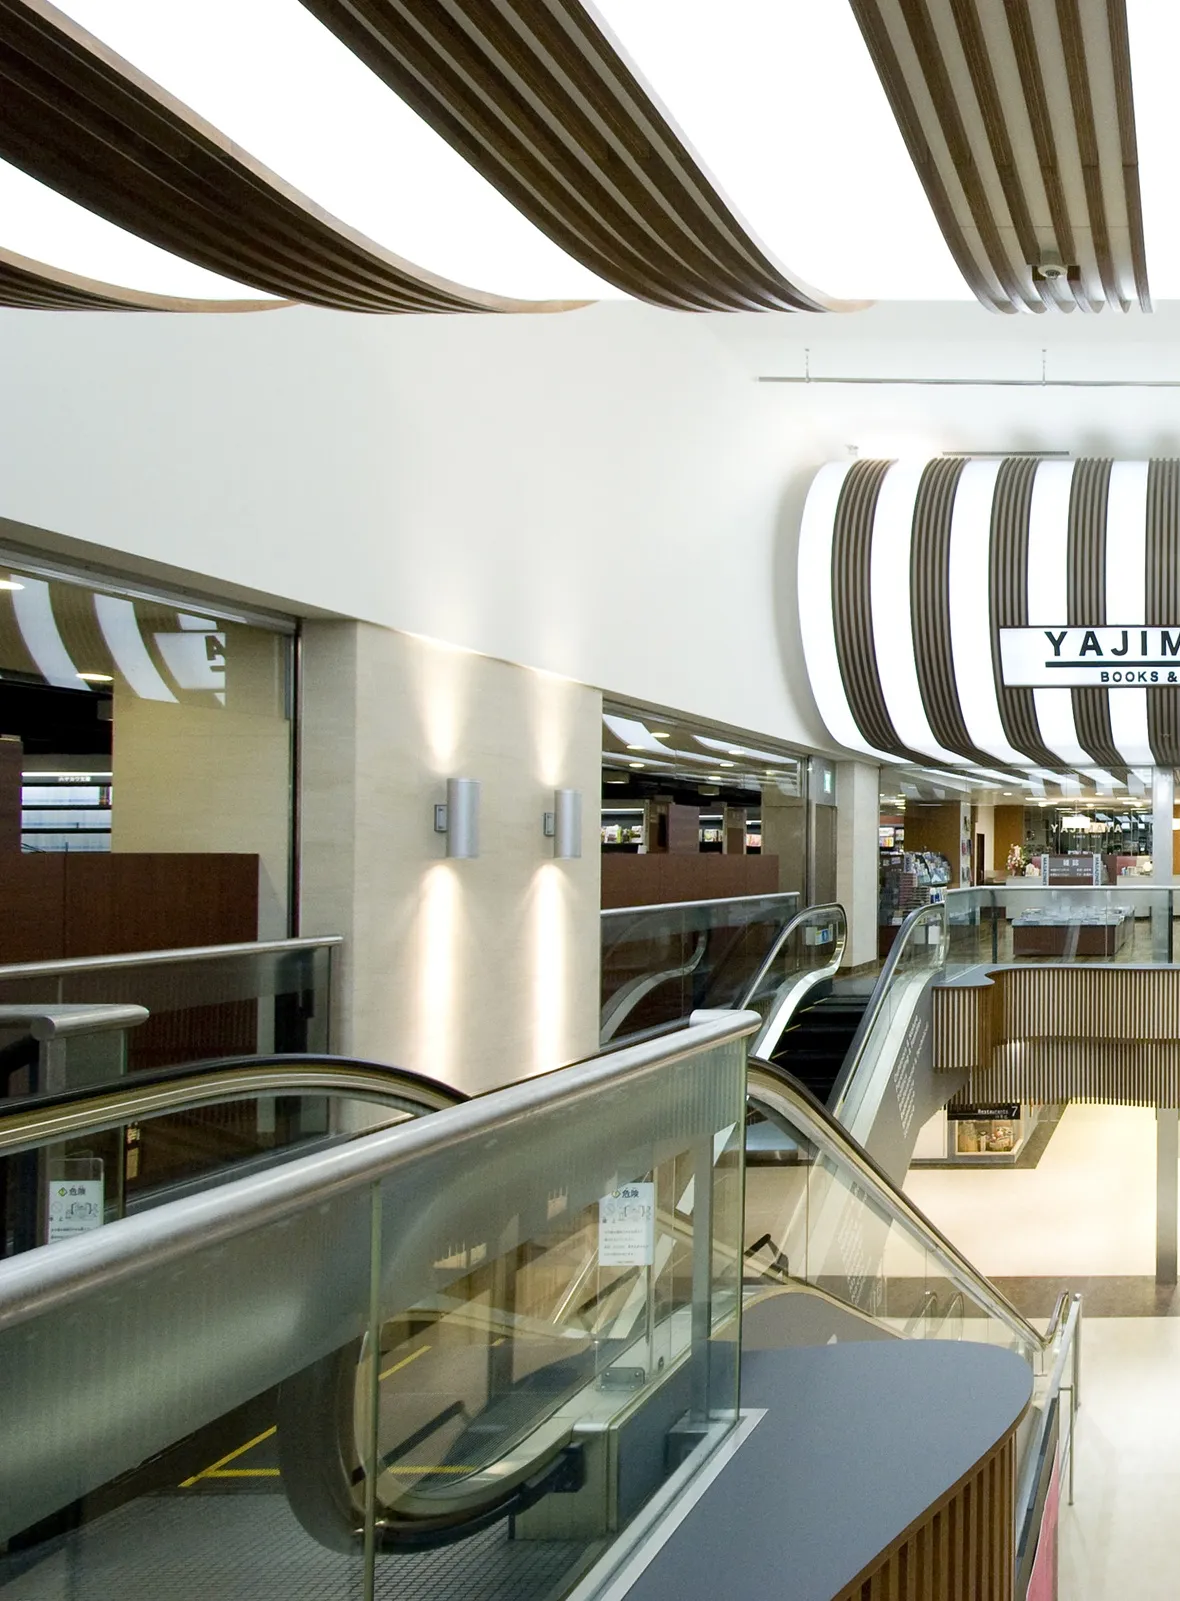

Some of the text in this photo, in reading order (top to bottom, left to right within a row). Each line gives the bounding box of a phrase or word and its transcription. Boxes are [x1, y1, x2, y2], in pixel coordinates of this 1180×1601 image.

[1100, 671, 1159, 683] BOOKS
[1167, 671, 1178, 683] &
[1011, 1105, 1018, 1117] 7
[622, 1189, 640, 1198] 危険
